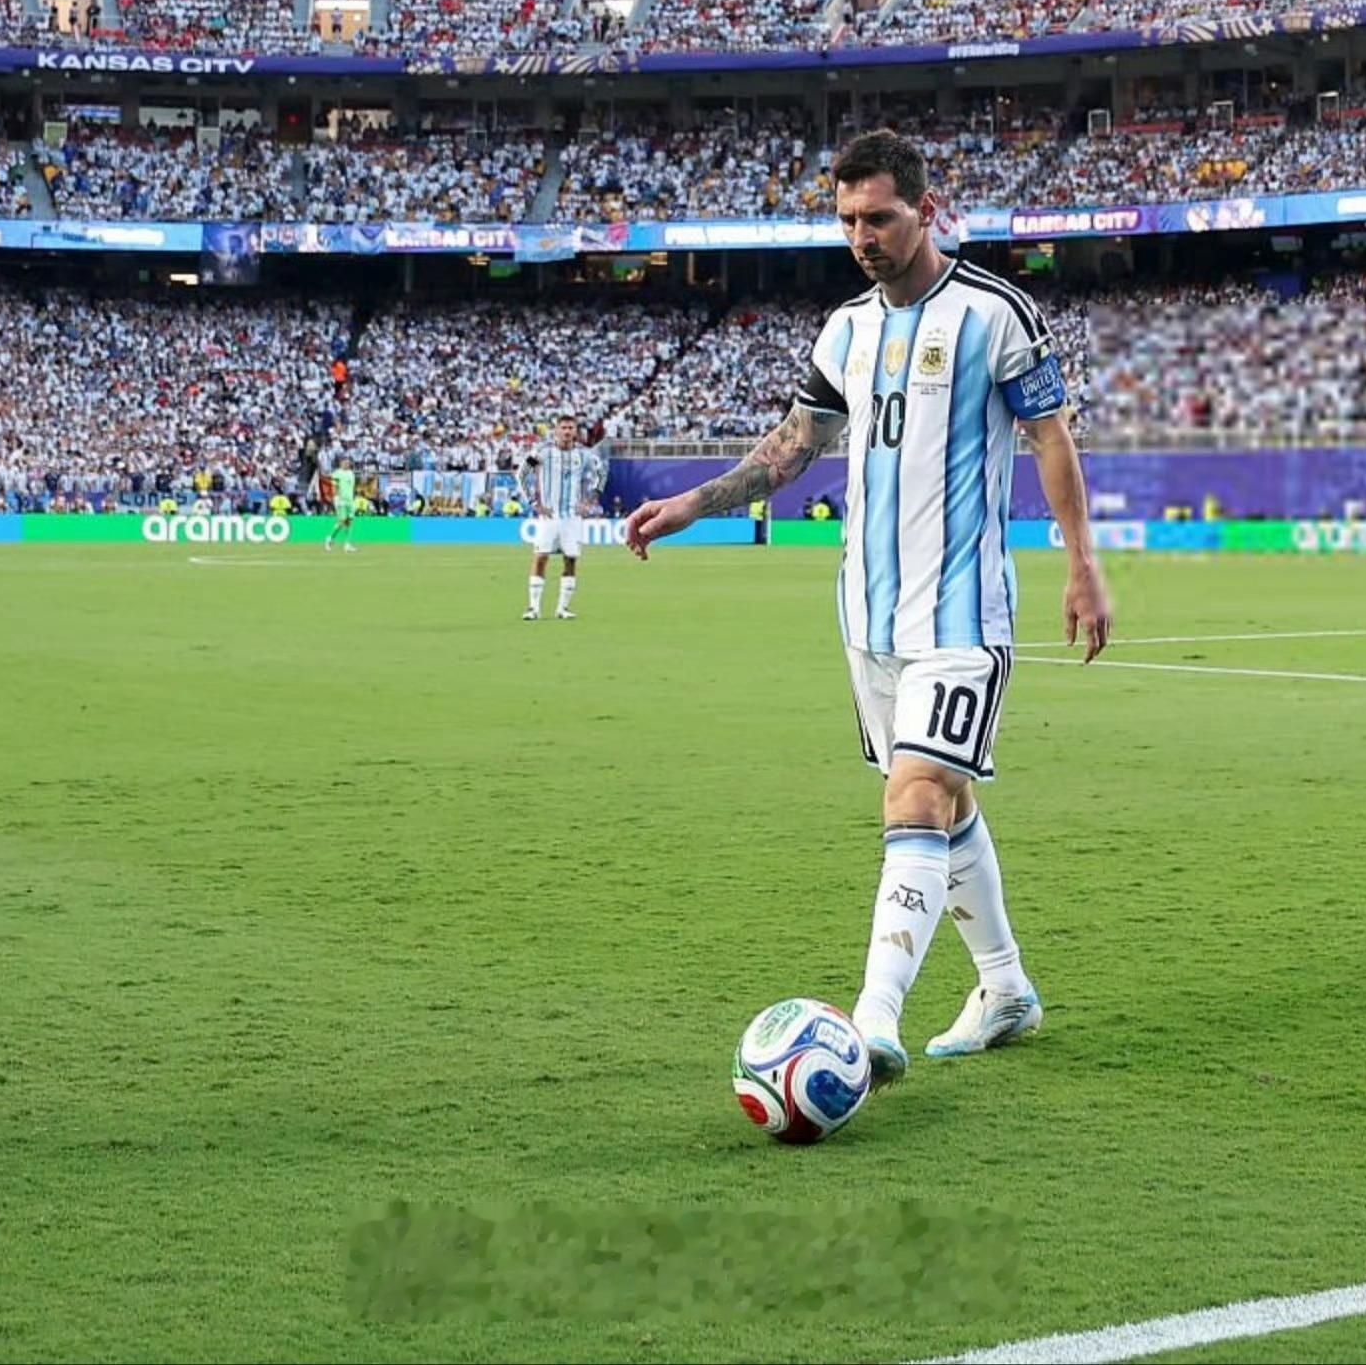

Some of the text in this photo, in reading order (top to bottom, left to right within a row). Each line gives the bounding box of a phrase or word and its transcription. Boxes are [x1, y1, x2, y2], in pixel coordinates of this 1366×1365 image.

[38, 53, 254, 74] KANSAS CITY
[871, 391, 906, 449] 10
[142, 514, 290, 542] aramco
[927, 681, 977, 745] 10
